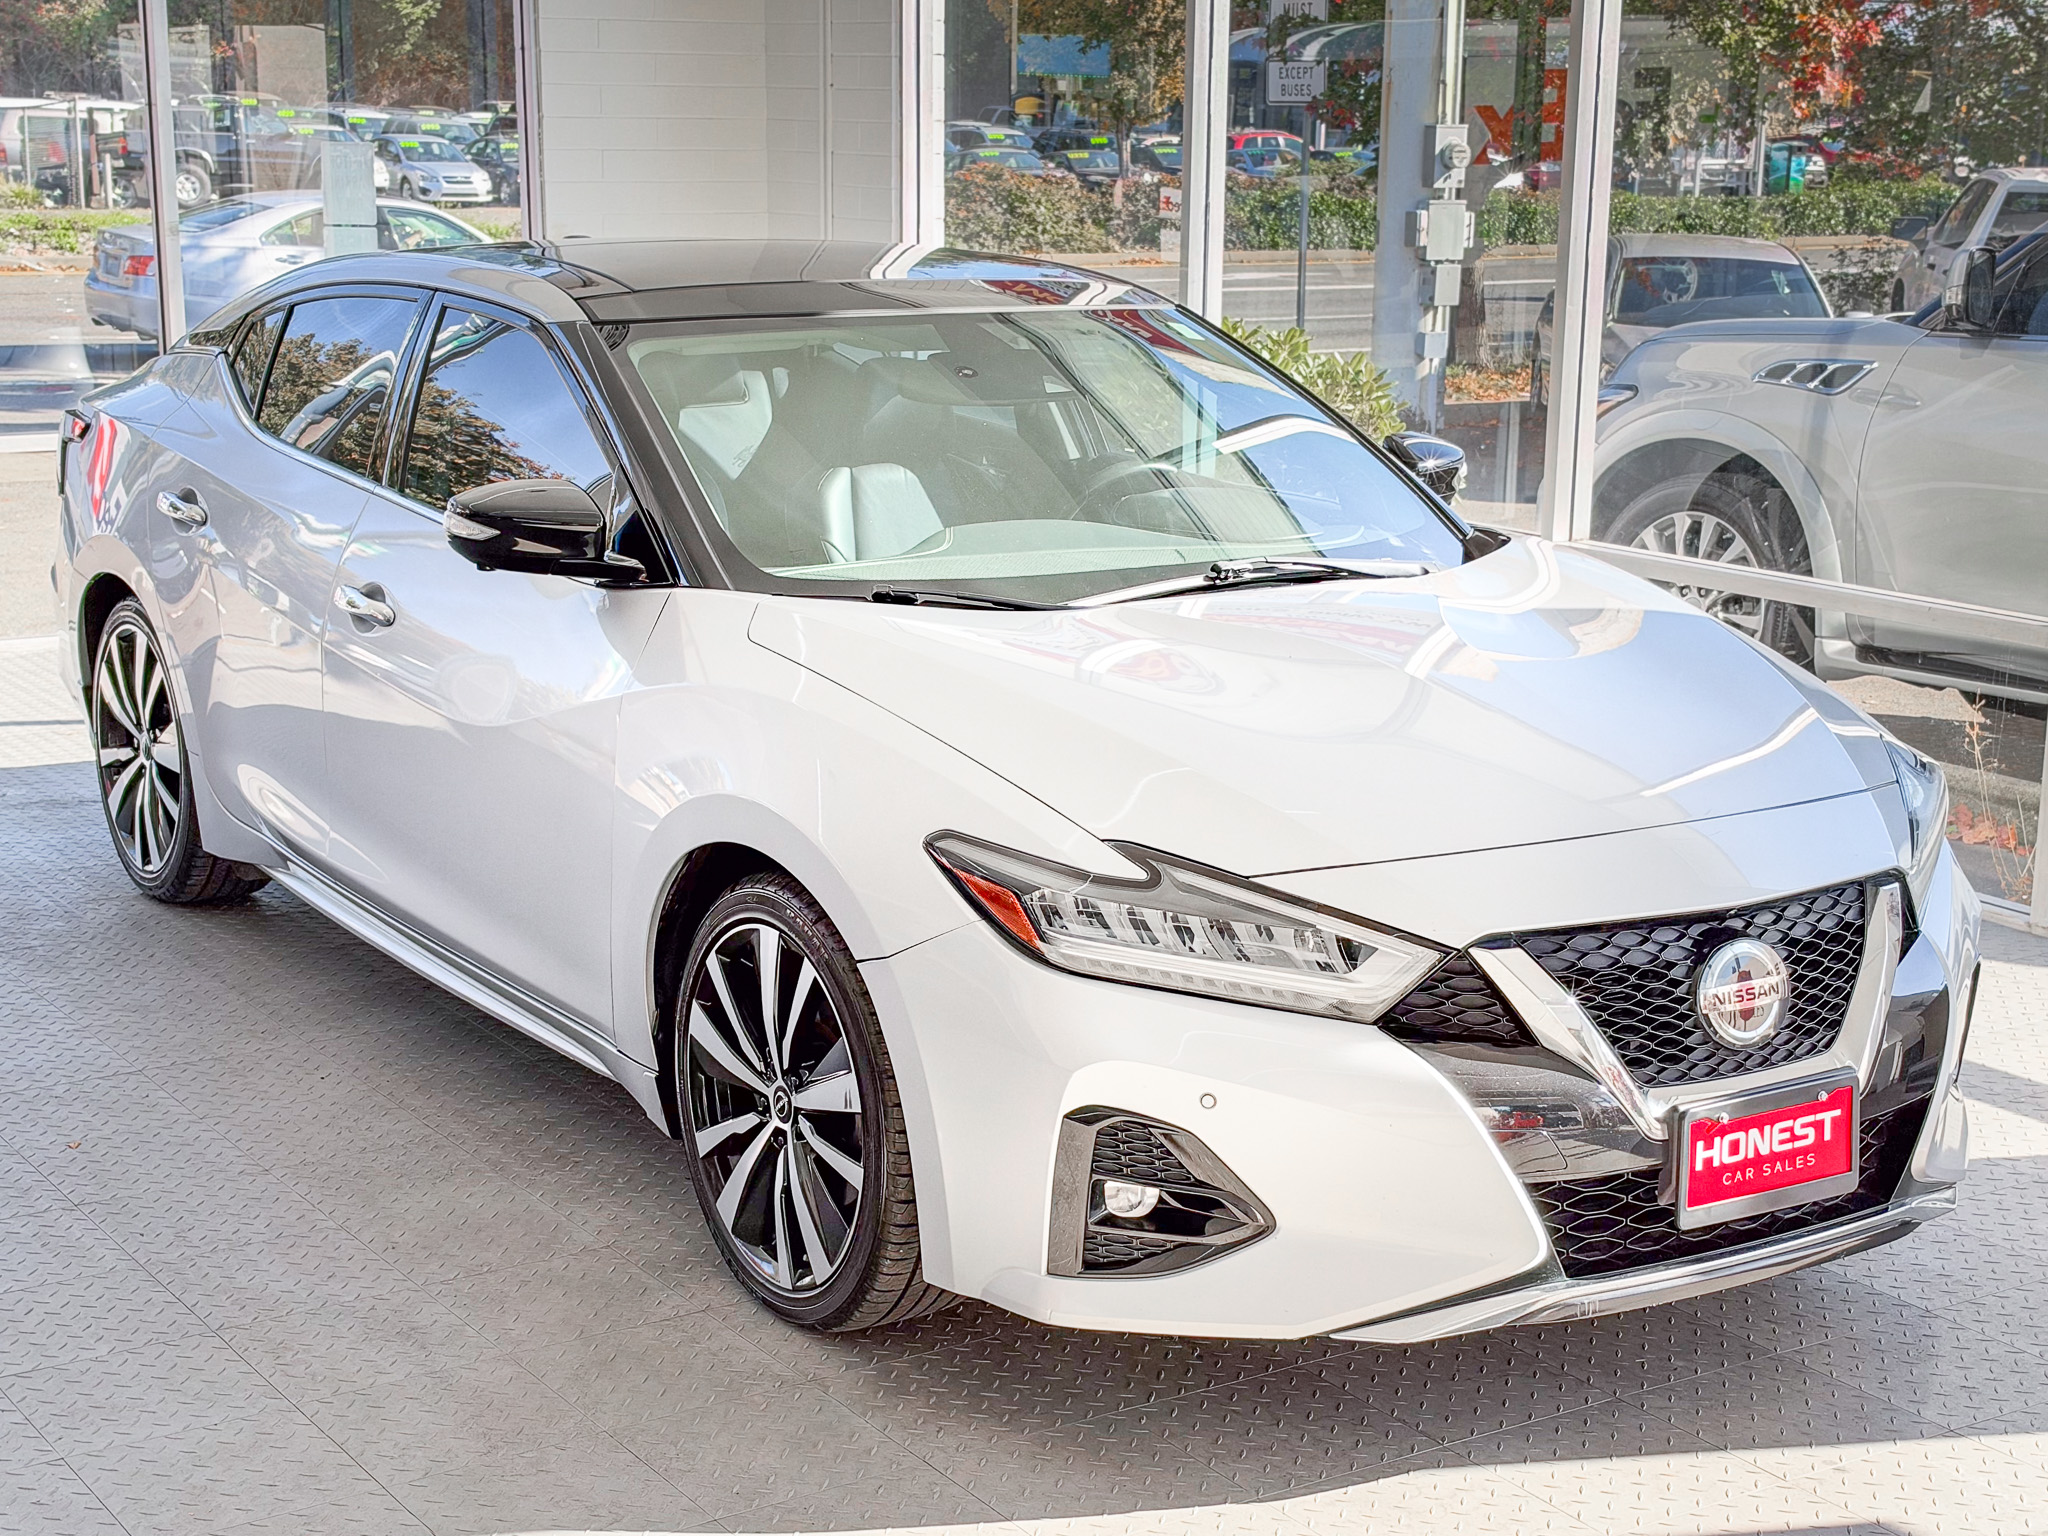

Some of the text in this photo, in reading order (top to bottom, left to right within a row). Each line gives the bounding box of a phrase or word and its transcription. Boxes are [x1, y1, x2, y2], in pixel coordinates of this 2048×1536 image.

[1283, 3, 1313, 18] MUST
[1278, 66, 1313, 80] EXCEPT
[1280, 84, 1312, 97] BUSES
[1712, 981, 1780, 1006] NISSAN
[1695, 1108, 1842, 1171] HONEST
[1722, 1153, 1816, 1186] CAR SALES
